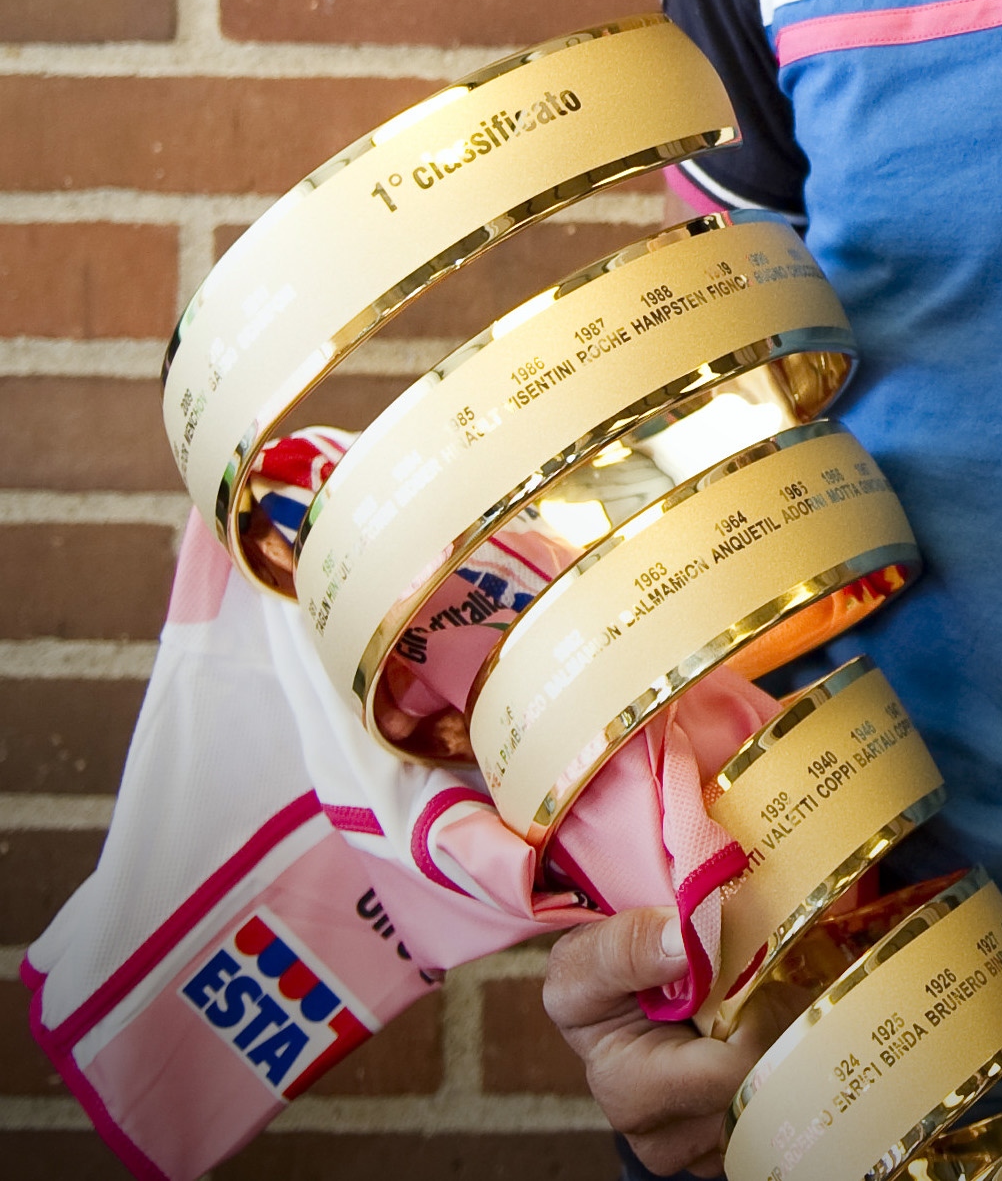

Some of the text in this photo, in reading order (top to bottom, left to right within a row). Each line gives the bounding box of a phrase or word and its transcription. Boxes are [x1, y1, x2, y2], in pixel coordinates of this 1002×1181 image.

[412, 89, 582, 190] classificato
[510, 357, 545, 385] 1986
[574, 318, 605, 344] 1987
[640, 285, 673, 308] 1988
[576, 327, 631, 366] ROCHE
[630, 290, 708, 335] HAMPSTEN
[711, 516, 781, 564] ANQUETIL
[714, 510, 748, 536] 1964
[779, 480, 808, 502] 1965
[634, 562, 668, 591] 1963
[762, 794, 819, 849] VALETTI
[816, 761, 858, 799] COPPI
[853, 734, 896, 769] BARTALI
[807, 750, 838, 779] 1940
[182, 949, 310, 1087] ESTA
[831, 1053, 860, 1084] 924
[870, 1012, 906, 1046] 1925
[924, 968, 957, 998] 1926
[976, 930, 999, 956] 1927
[879, 1023, 929, 1068] BINDA
[924, 969, 988, 1027] BRUNERO
